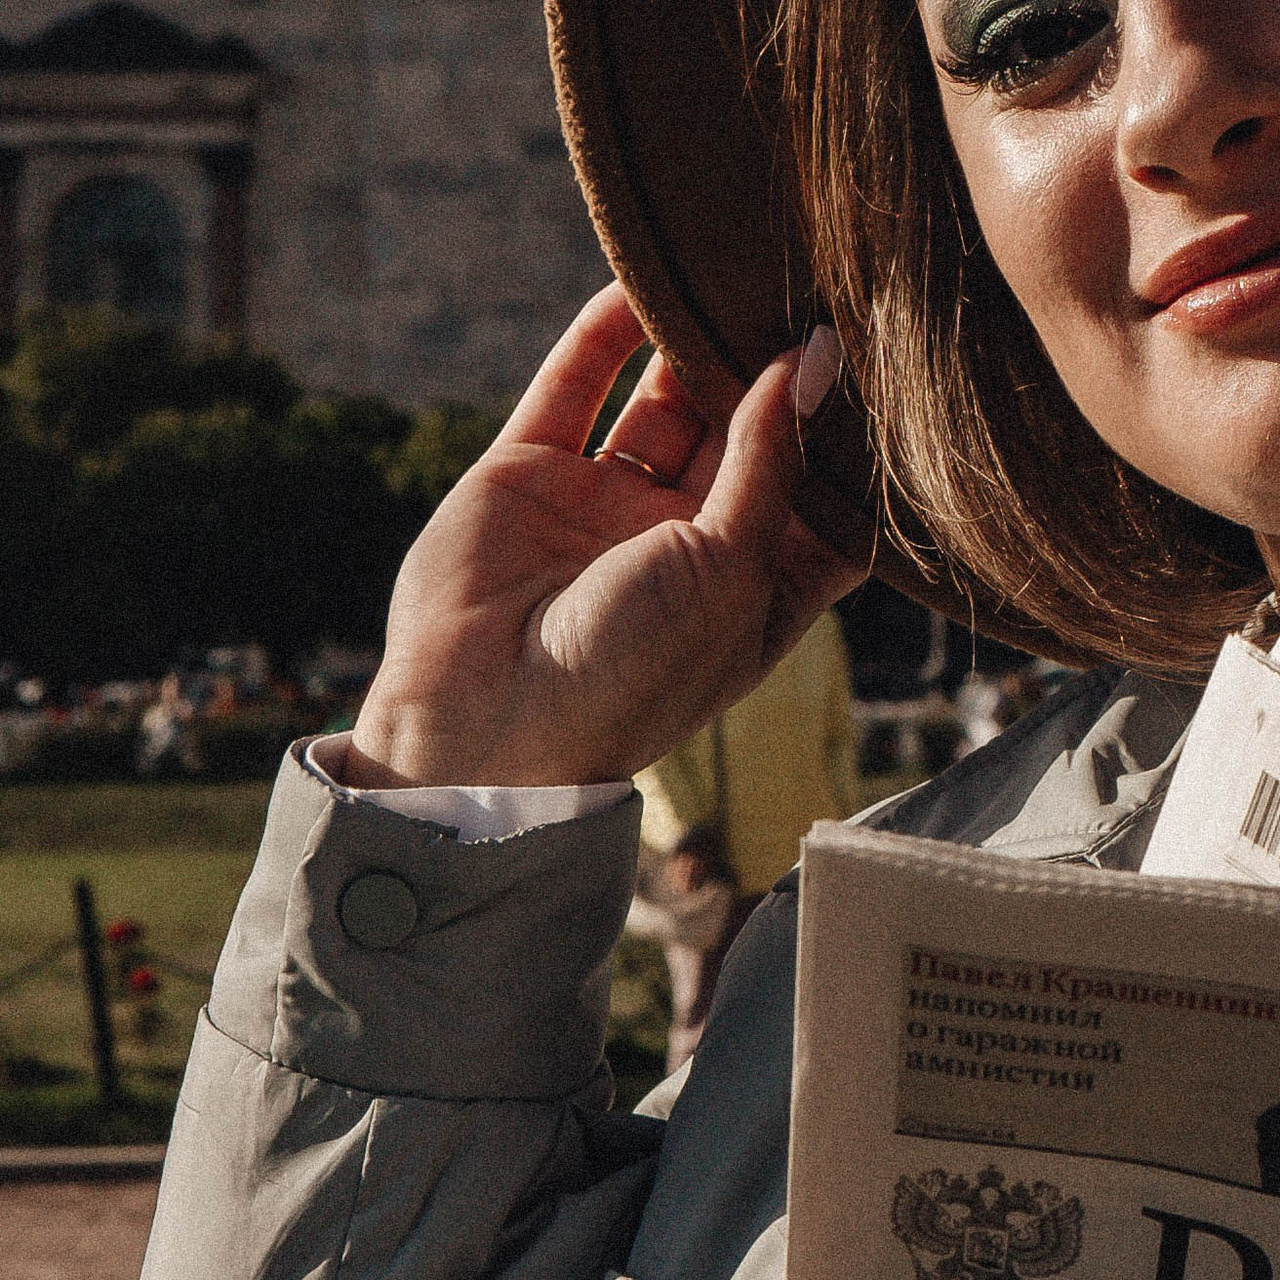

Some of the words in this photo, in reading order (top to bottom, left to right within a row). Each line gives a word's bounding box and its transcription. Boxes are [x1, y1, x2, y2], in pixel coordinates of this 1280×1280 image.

[909, 950, 1032, 993] Павел
[907, 988, 1102, 1030] напомнил
[905, 1019, 928, 1039] о
[936, 1023, 1124, 1064] гаражной
[905, 1050, 1096, 1092] амнистии
